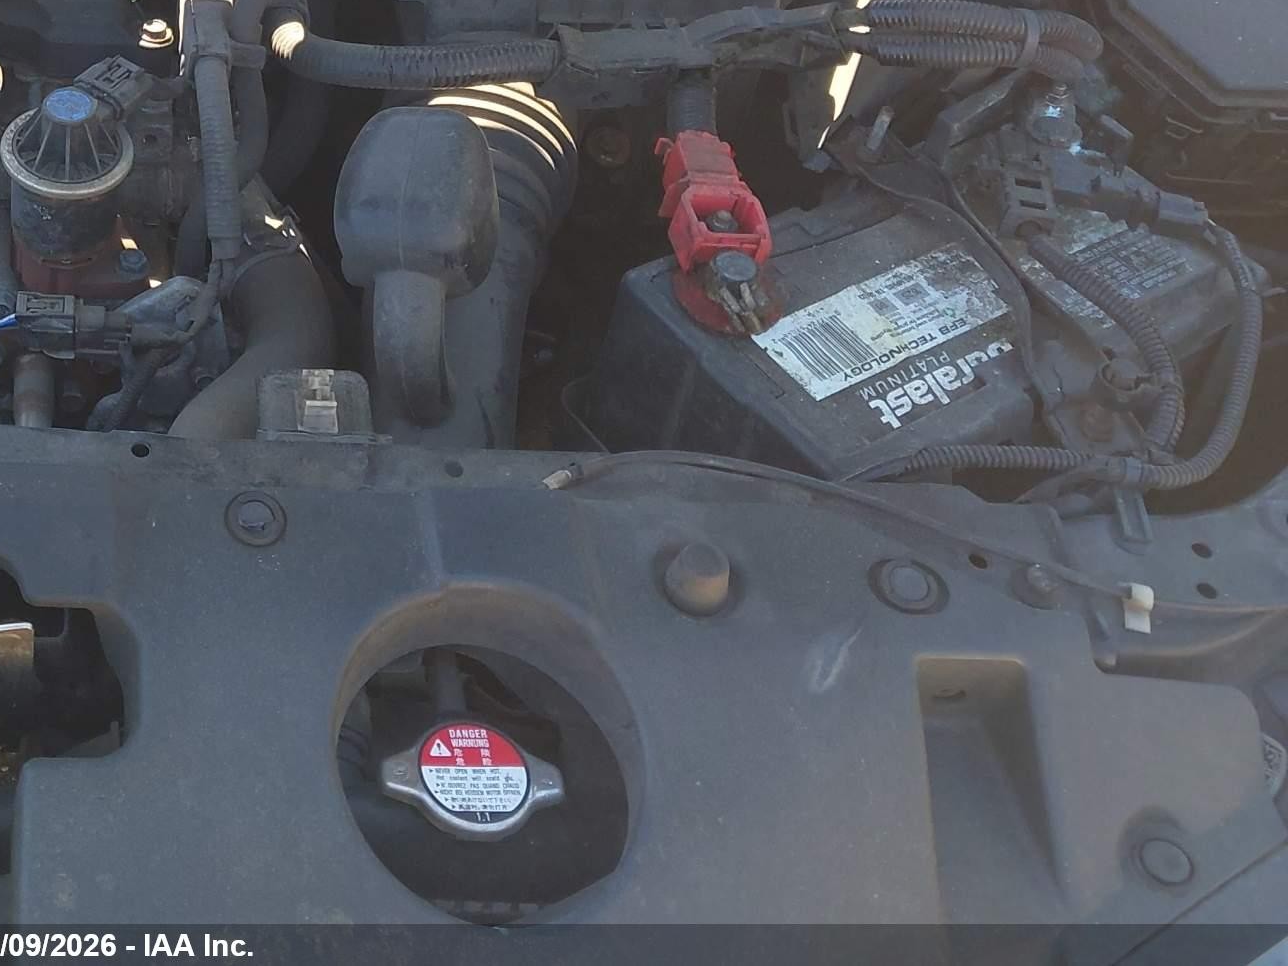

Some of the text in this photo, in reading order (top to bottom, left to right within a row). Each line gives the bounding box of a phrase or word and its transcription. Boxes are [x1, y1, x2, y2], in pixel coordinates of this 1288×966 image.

[941, 317, 971, 335] EFB
[843, 332, 936, 382] TECHNOLOGY
[858, 350, 951, 402] PLATINUM
[449, 729, 487, 739] DANGER
[476, 812, 491, 822] 1.1
